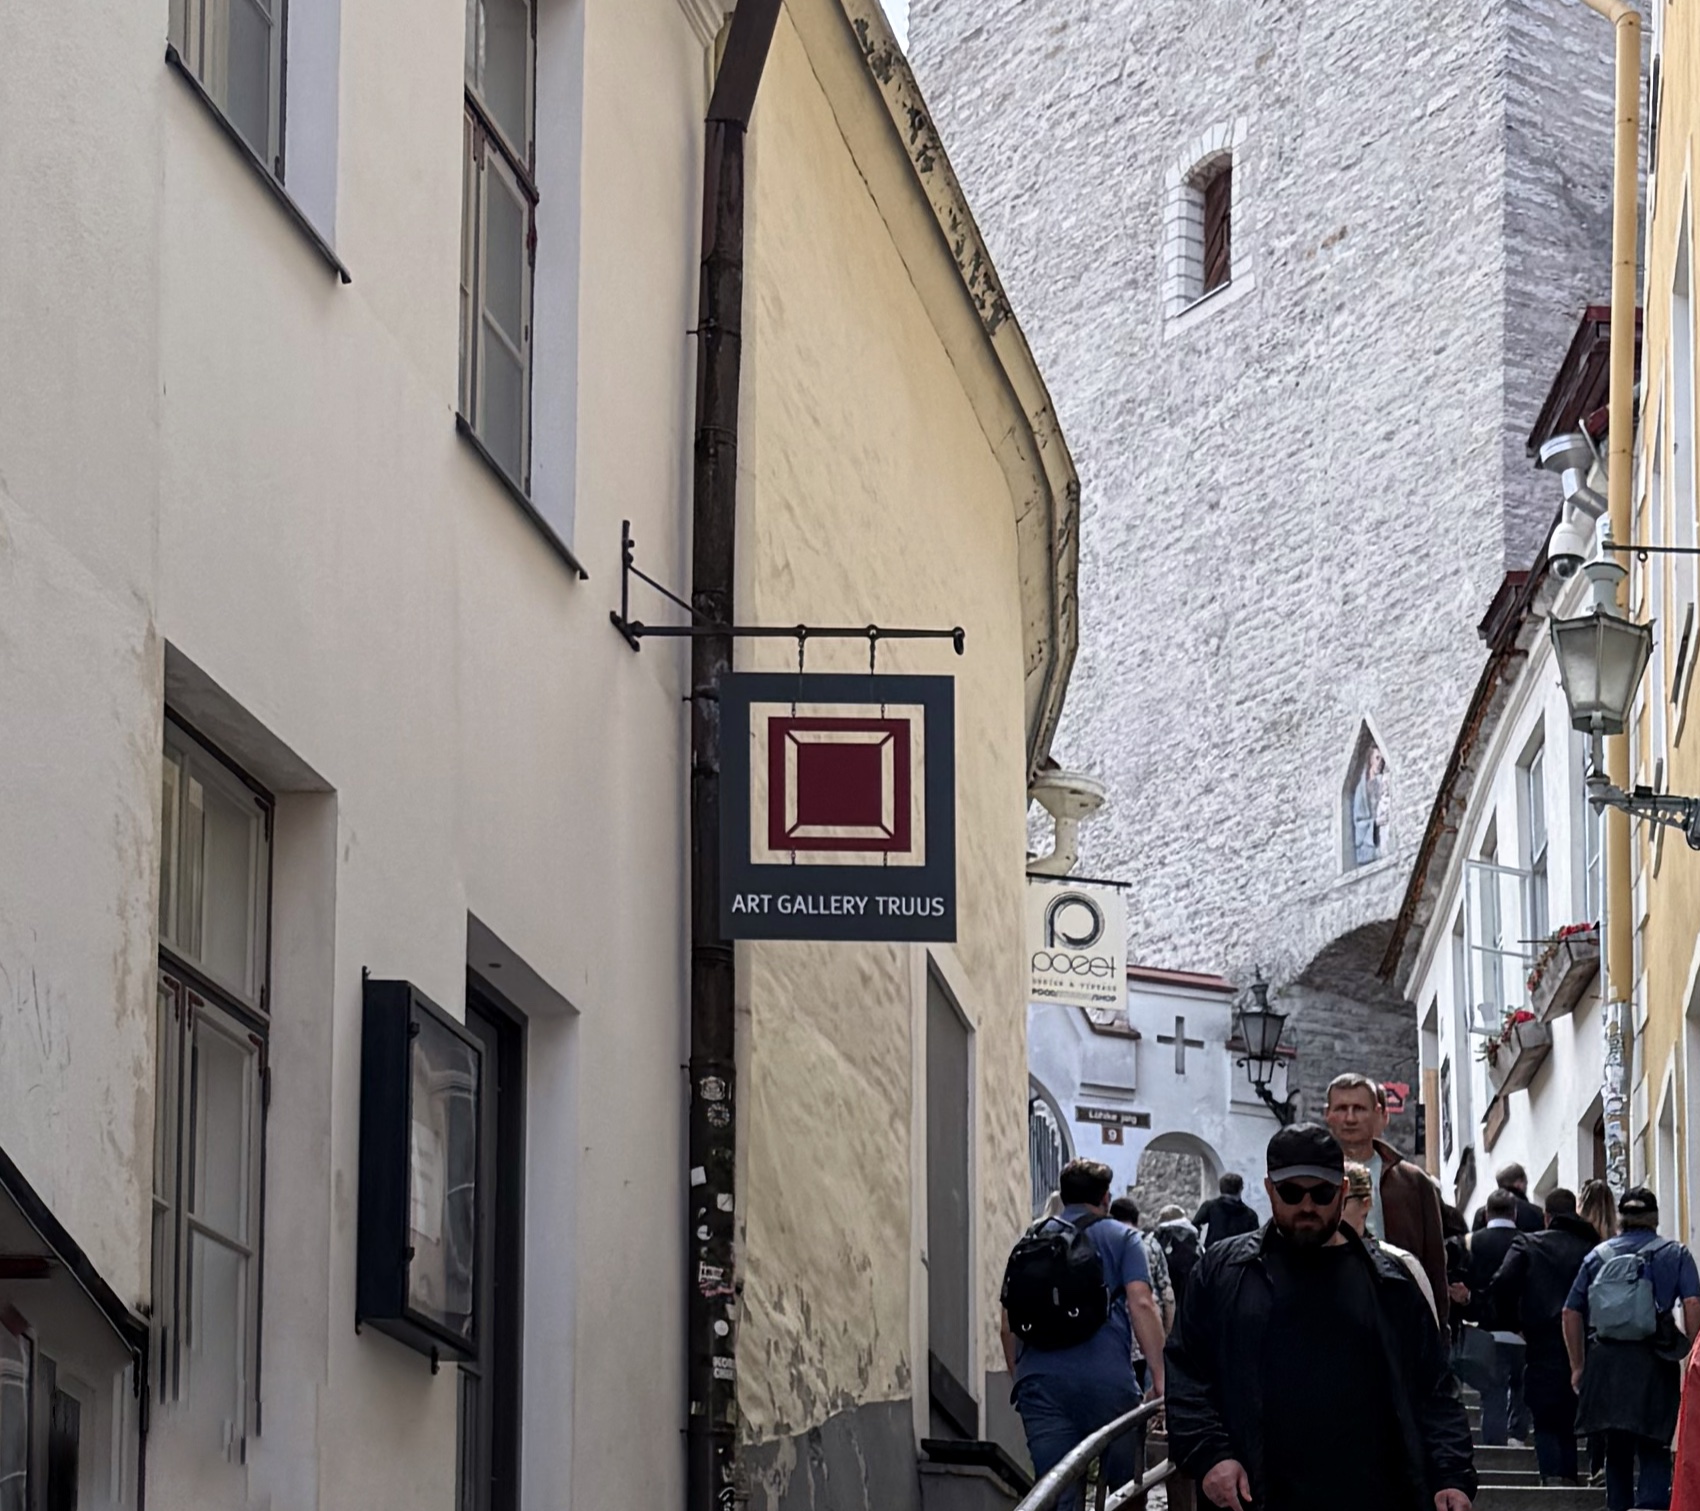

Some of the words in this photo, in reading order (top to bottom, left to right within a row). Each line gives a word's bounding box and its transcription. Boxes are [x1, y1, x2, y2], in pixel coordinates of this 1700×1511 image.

[731, 894, 772, 914] ART
[777, 895, 868, 915] GALLERY
[875, 896, 945, 916] TRUUS
[1108, 1129, 1117, 1142] 9
